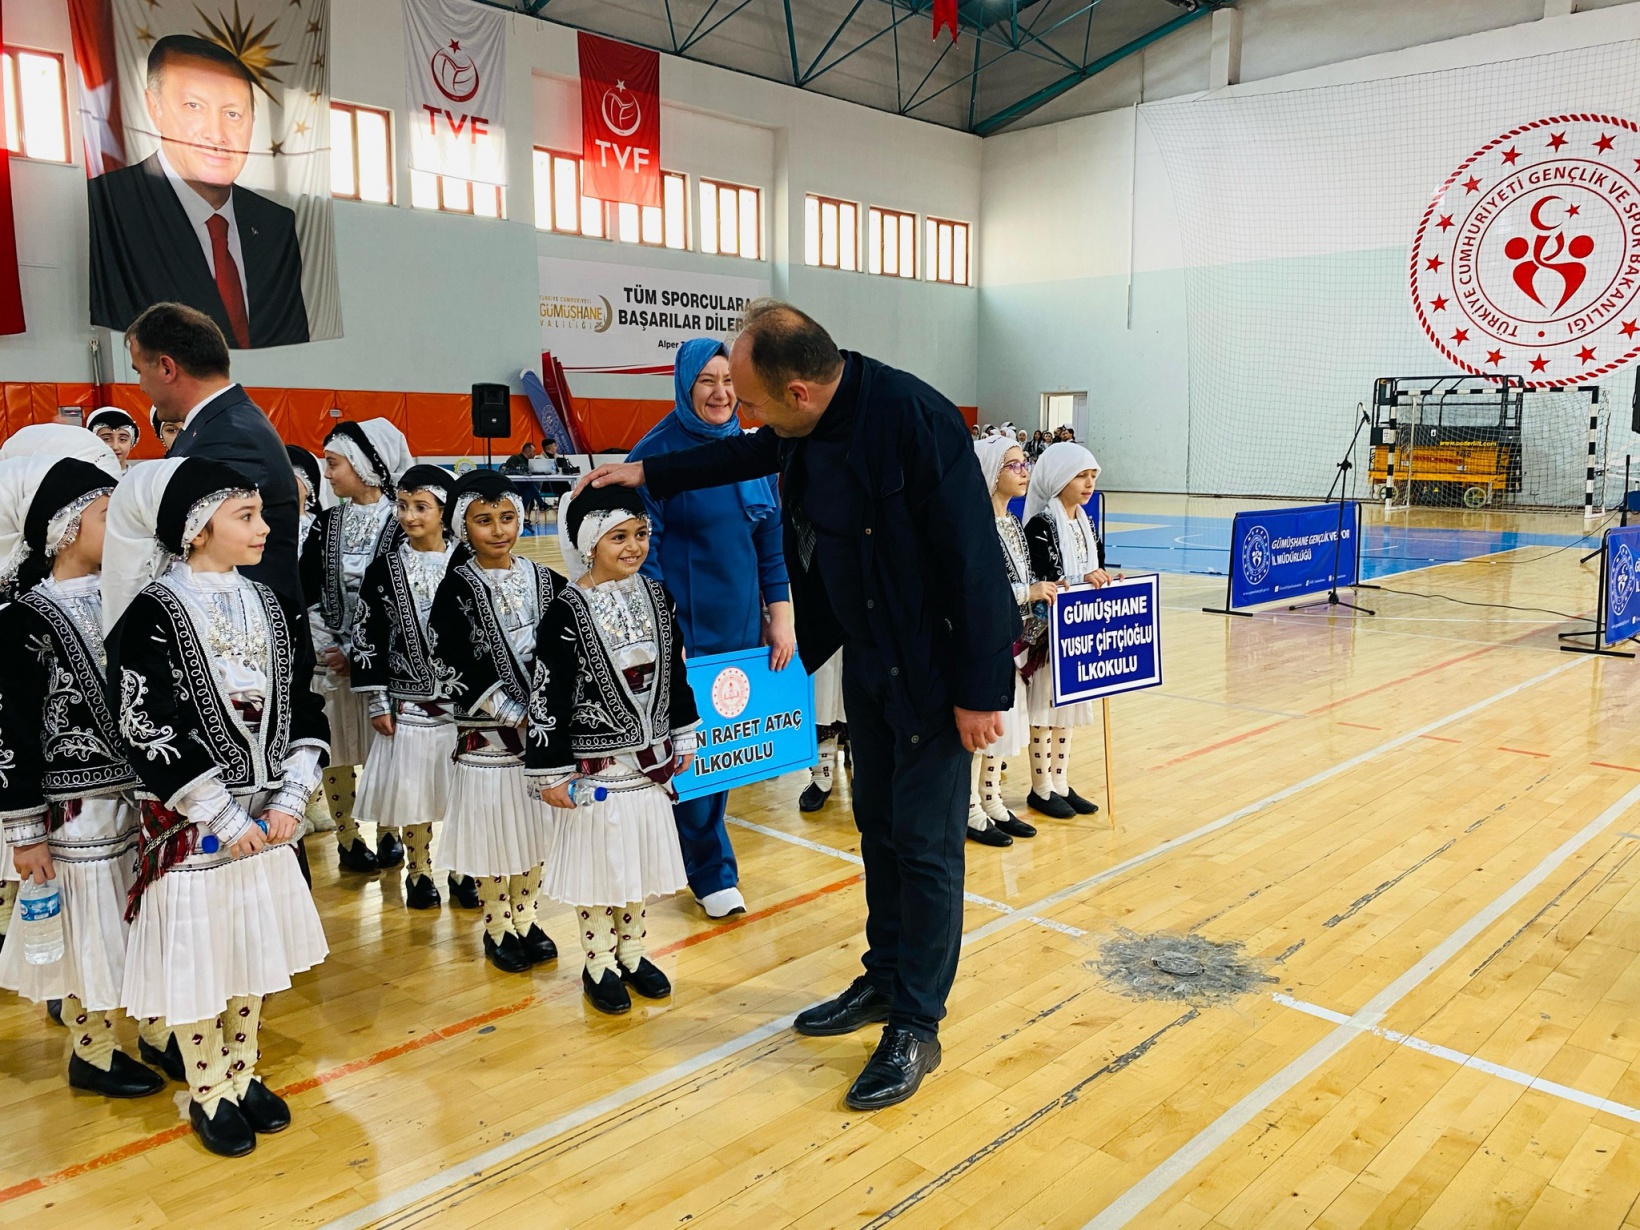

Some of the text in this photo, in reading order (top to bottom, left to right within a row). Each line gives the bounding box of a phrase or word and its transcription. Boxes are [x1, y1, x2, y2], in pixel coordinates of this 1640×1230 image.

[422, 103, 489, 145] TVF
[594, 138, 650, 174] TVF
[1528, 166, 1609, 188] GENÇLİK
[1608, 181, 1630, 203] VE
[1459, 176, 1524, 285] CUMHURİYETİ
[623, 284, 657, 305] TÜM
[1567, 254, 1640, 334] BAKANLIĞI
[540, 303, 603, 321] GÜMÜŞHANE
[618, 309, 701, 331] BAŞARILAR
[1463, 287, 1519, 338] TÜRKİYE
[657, 340, 680, 350] Alper
[1271, 536, 1309, 550] GÜMÜŞHANE
[1063, 595, 1148, 625] GÜMÜŞHANE
[1061, 623, 1152, 658] YUSUF ÇİFTÇİOĞLU
[1077, 655, 1138, 682] İLKOKULU
[712, 719, 760, 745] RAFET
[765, 710, 802, 730] ATAÇ
[694, 741, 773, 777] İLKOKULU
